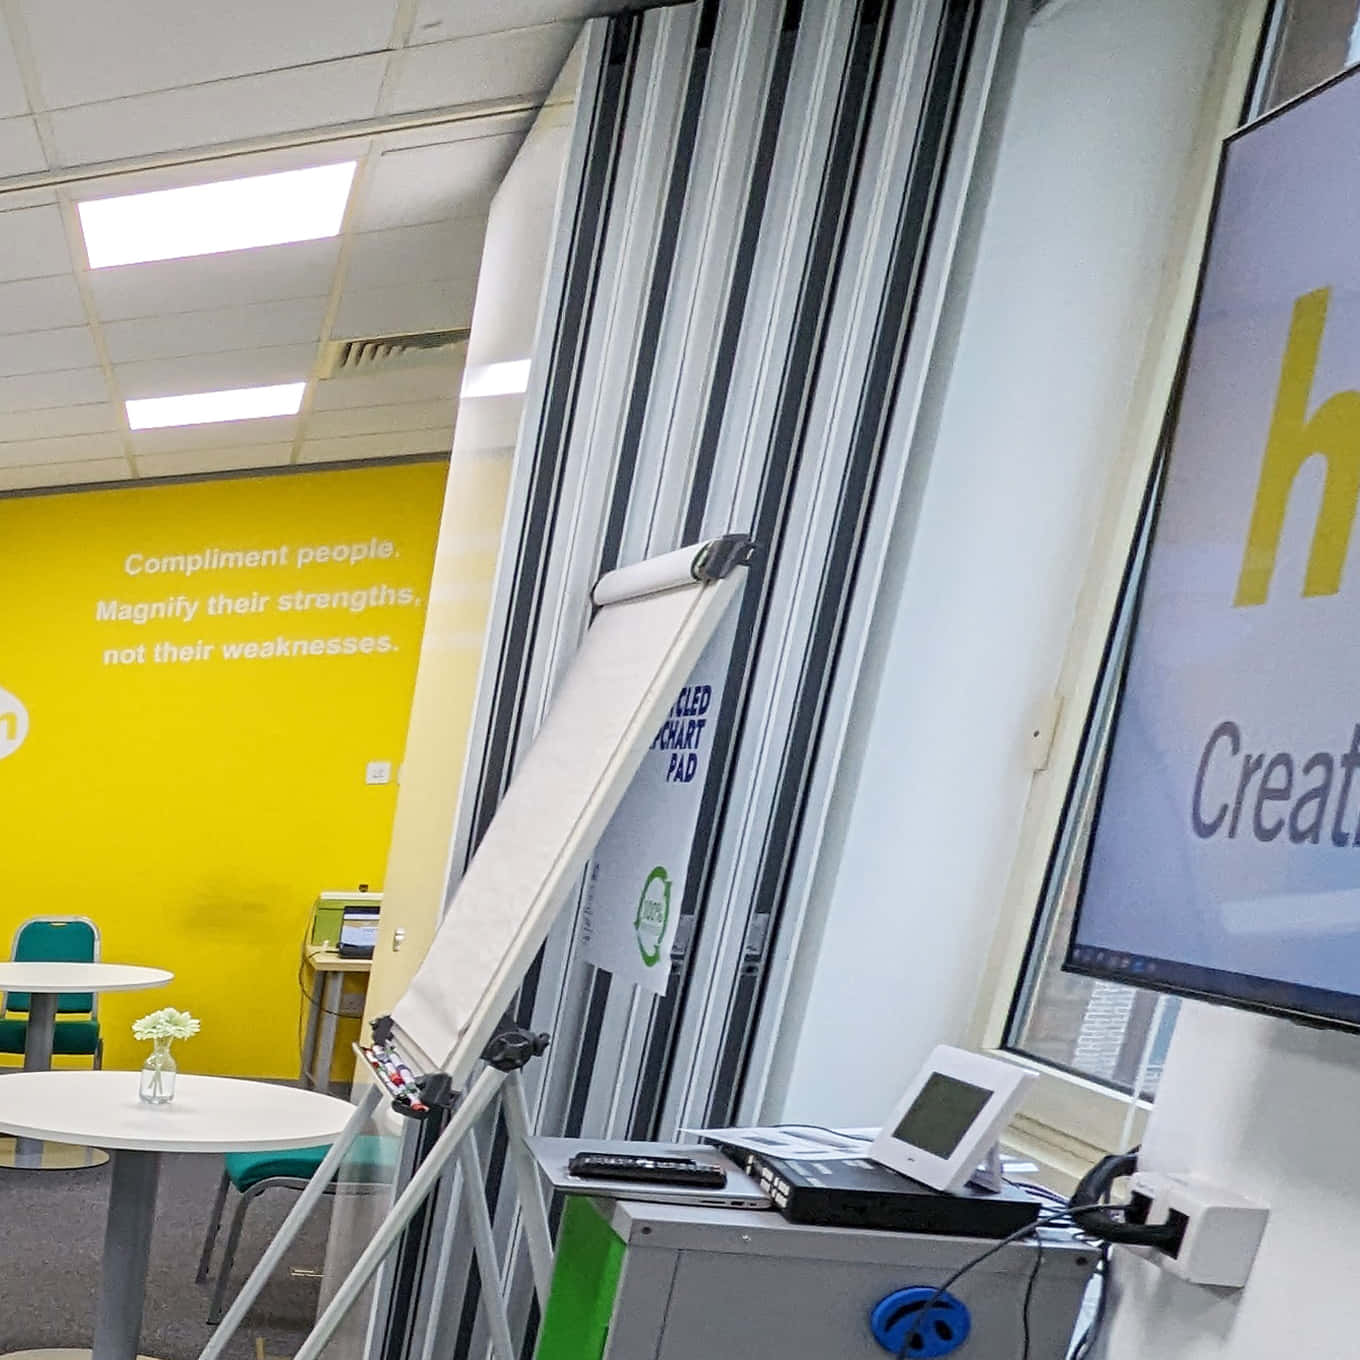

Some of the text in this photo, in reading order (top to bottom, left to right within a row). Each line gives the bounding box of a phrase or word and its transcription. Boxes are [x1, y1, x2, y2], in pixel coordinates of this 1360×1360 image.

[124, 537, 401, 577] Compliment people.
[95, 596, 198, 624] Magnify
[206, 591, 270, 616] their
[102, 634, 399, 665] not their weaknesses.
[666, 752, 698, 782] PAD
[1191, 720, 1360, 848] Creat
